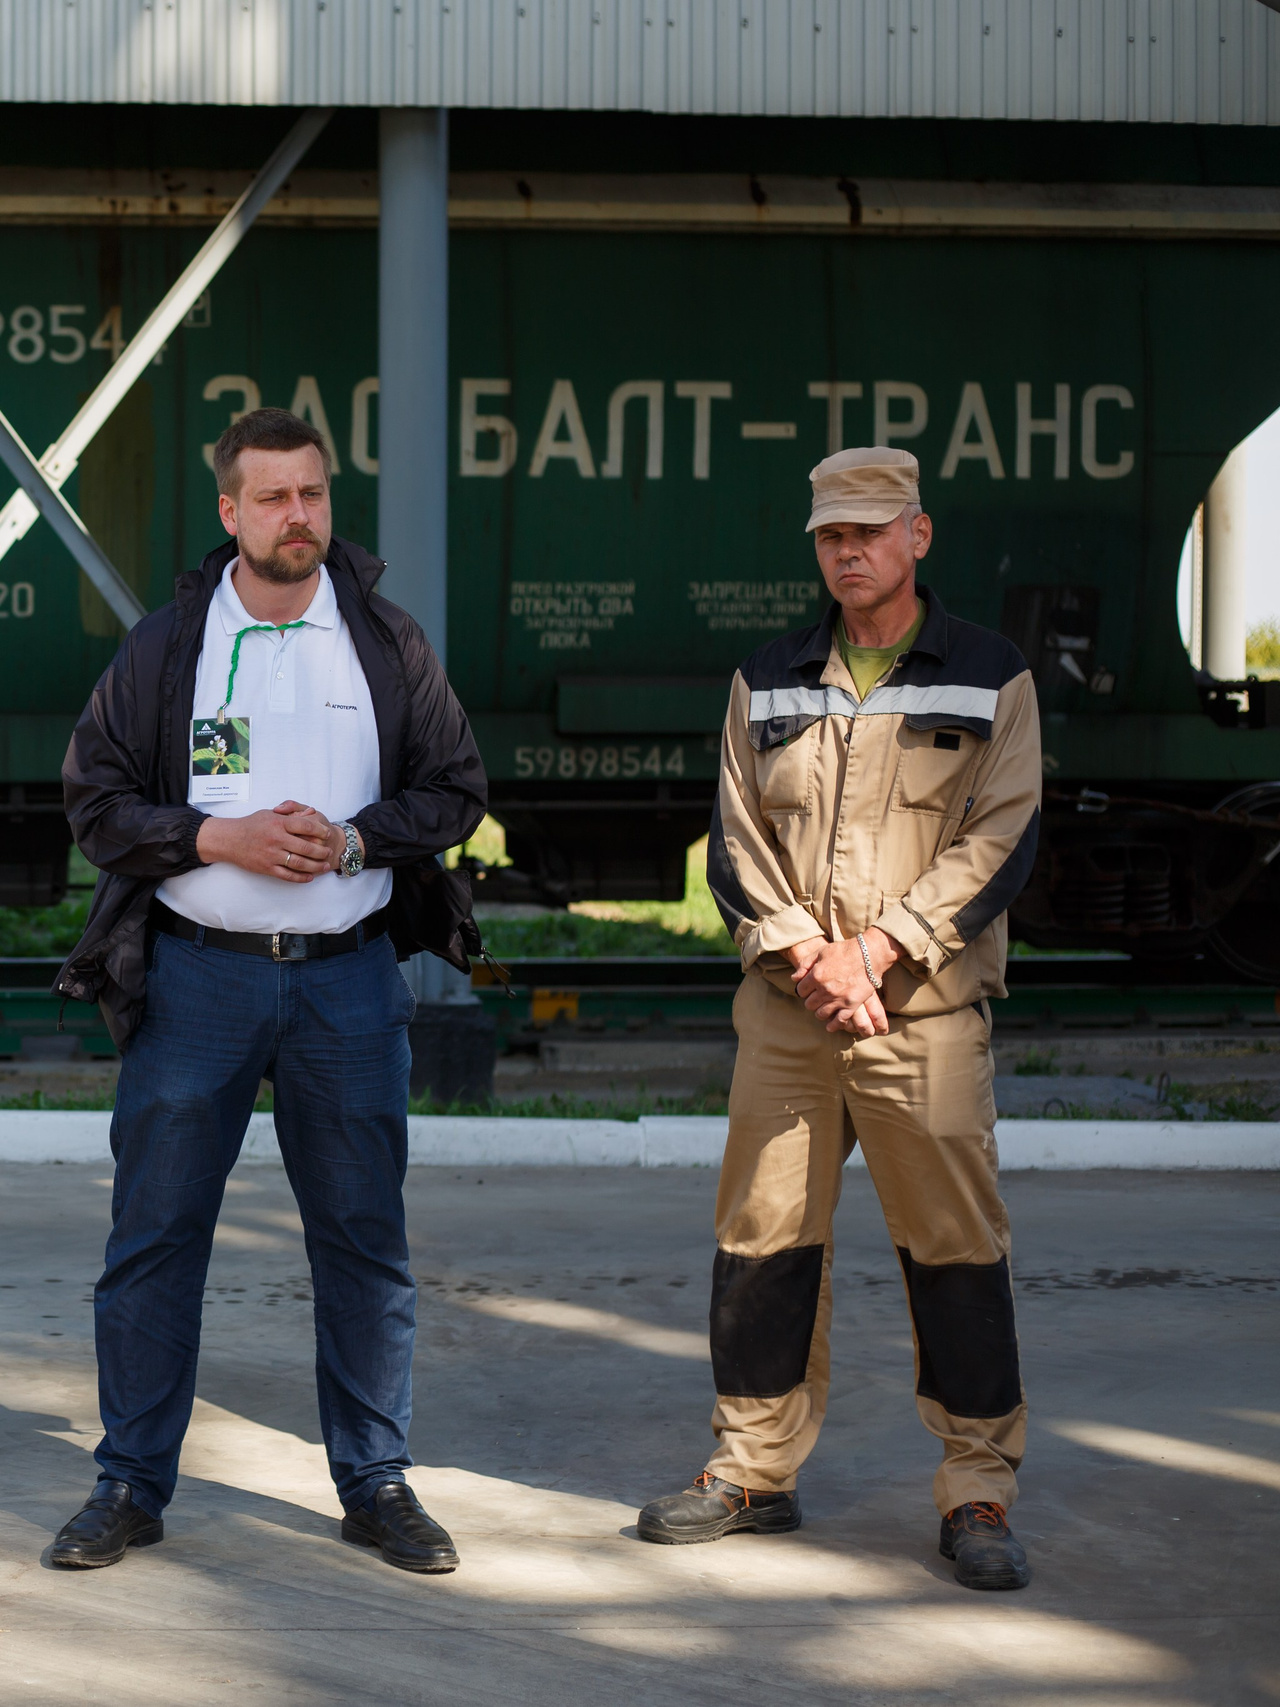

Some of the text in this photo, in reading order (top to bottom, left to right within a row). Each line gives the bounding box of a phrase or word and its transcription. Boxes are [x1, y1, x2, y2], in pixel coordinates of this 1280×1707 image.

[687, 581, 820, 601] ЗАПРЕЩАЕТСЯ
[510, 597, 594, 616] ОТКРЫТЬ
[539, 631, 592, 650] ЛЮКА
[514, 746, 687, 778] 59898544
